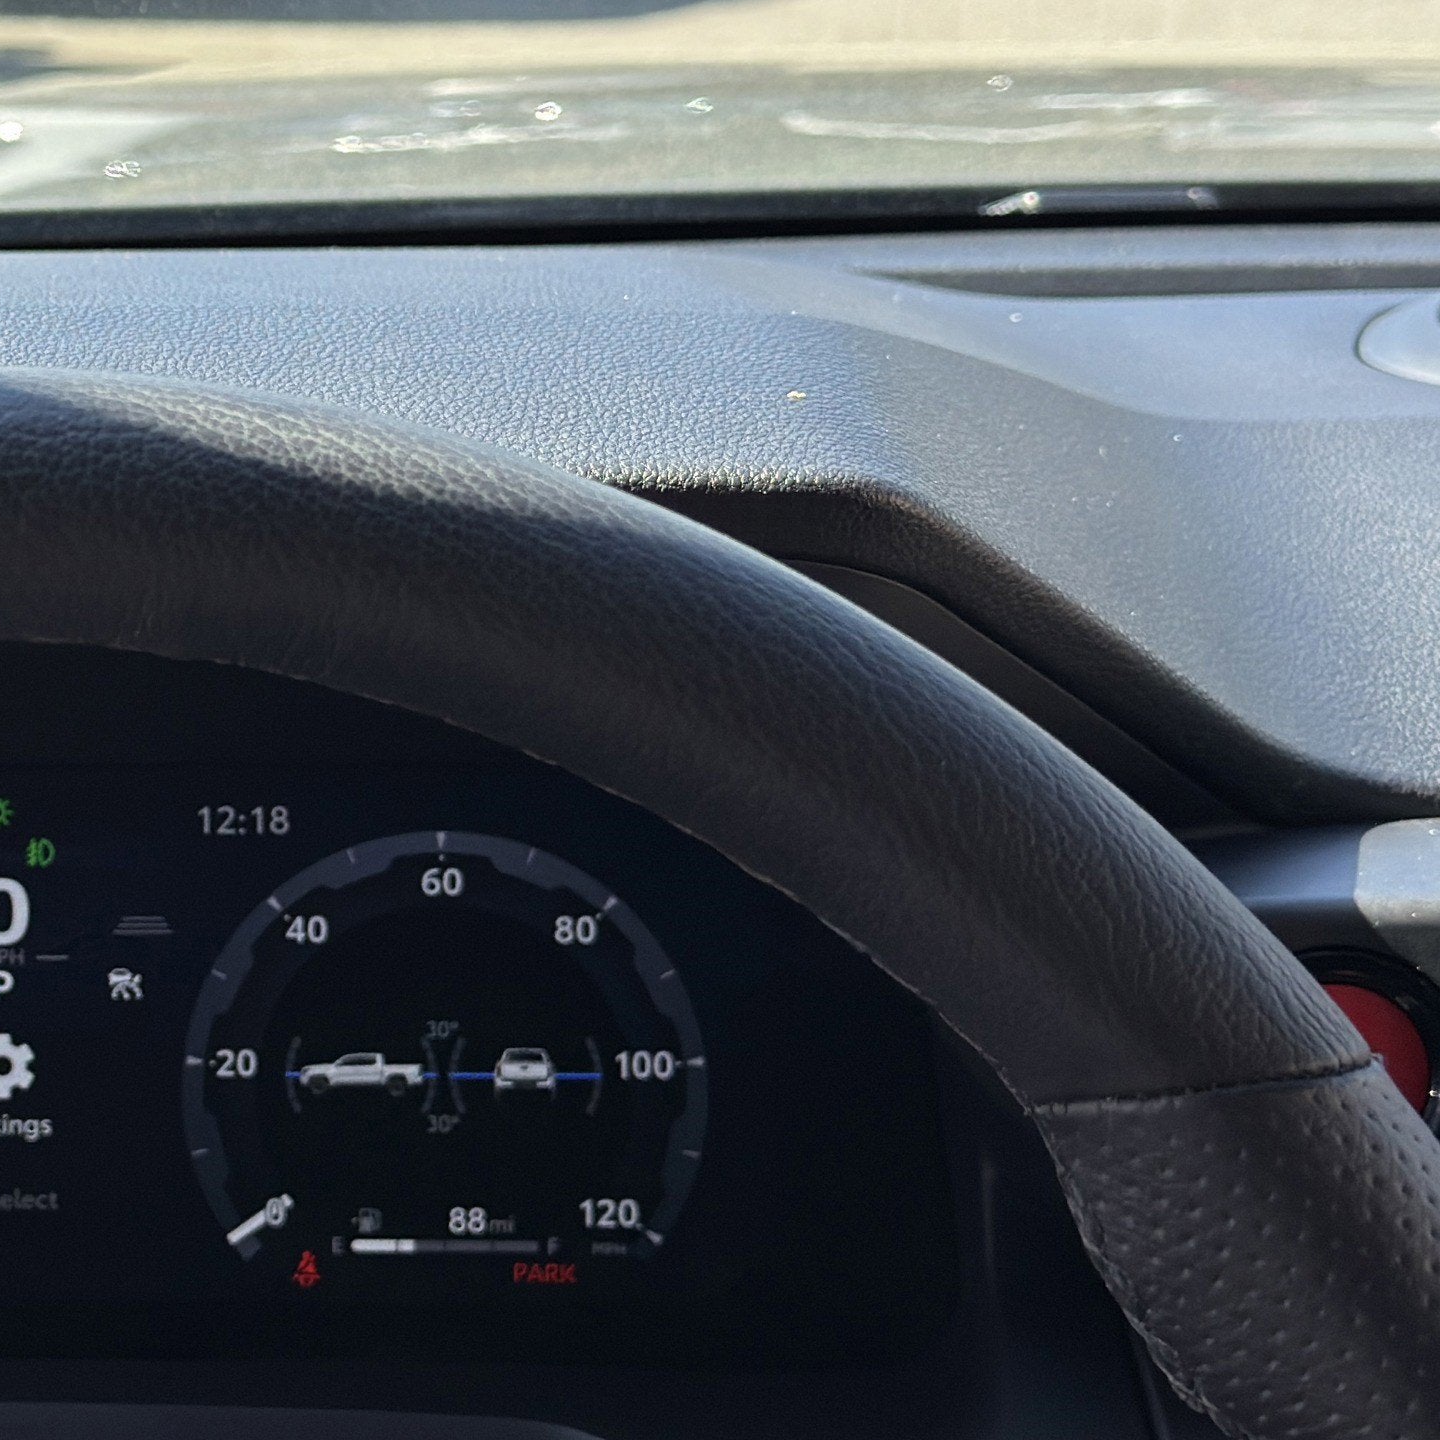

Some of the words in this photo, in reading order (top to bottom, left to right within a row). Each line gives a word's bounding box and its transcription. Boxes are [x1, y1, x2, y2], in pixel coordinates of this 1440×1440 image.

[197, 806, 289, 835] 12:18
[421, 868, 464, 897] 60
[285, 915, 329, 945] 40
[553, 915, 597, 945] 80
[215, 1050, 258, 1078] 20
[615, 1050, 675, 1079] 100
[448, 1208, 486, 1235] 88
[579, 1199, 641, 1228] 120
[513, 1262, 577, 1284] PARK
